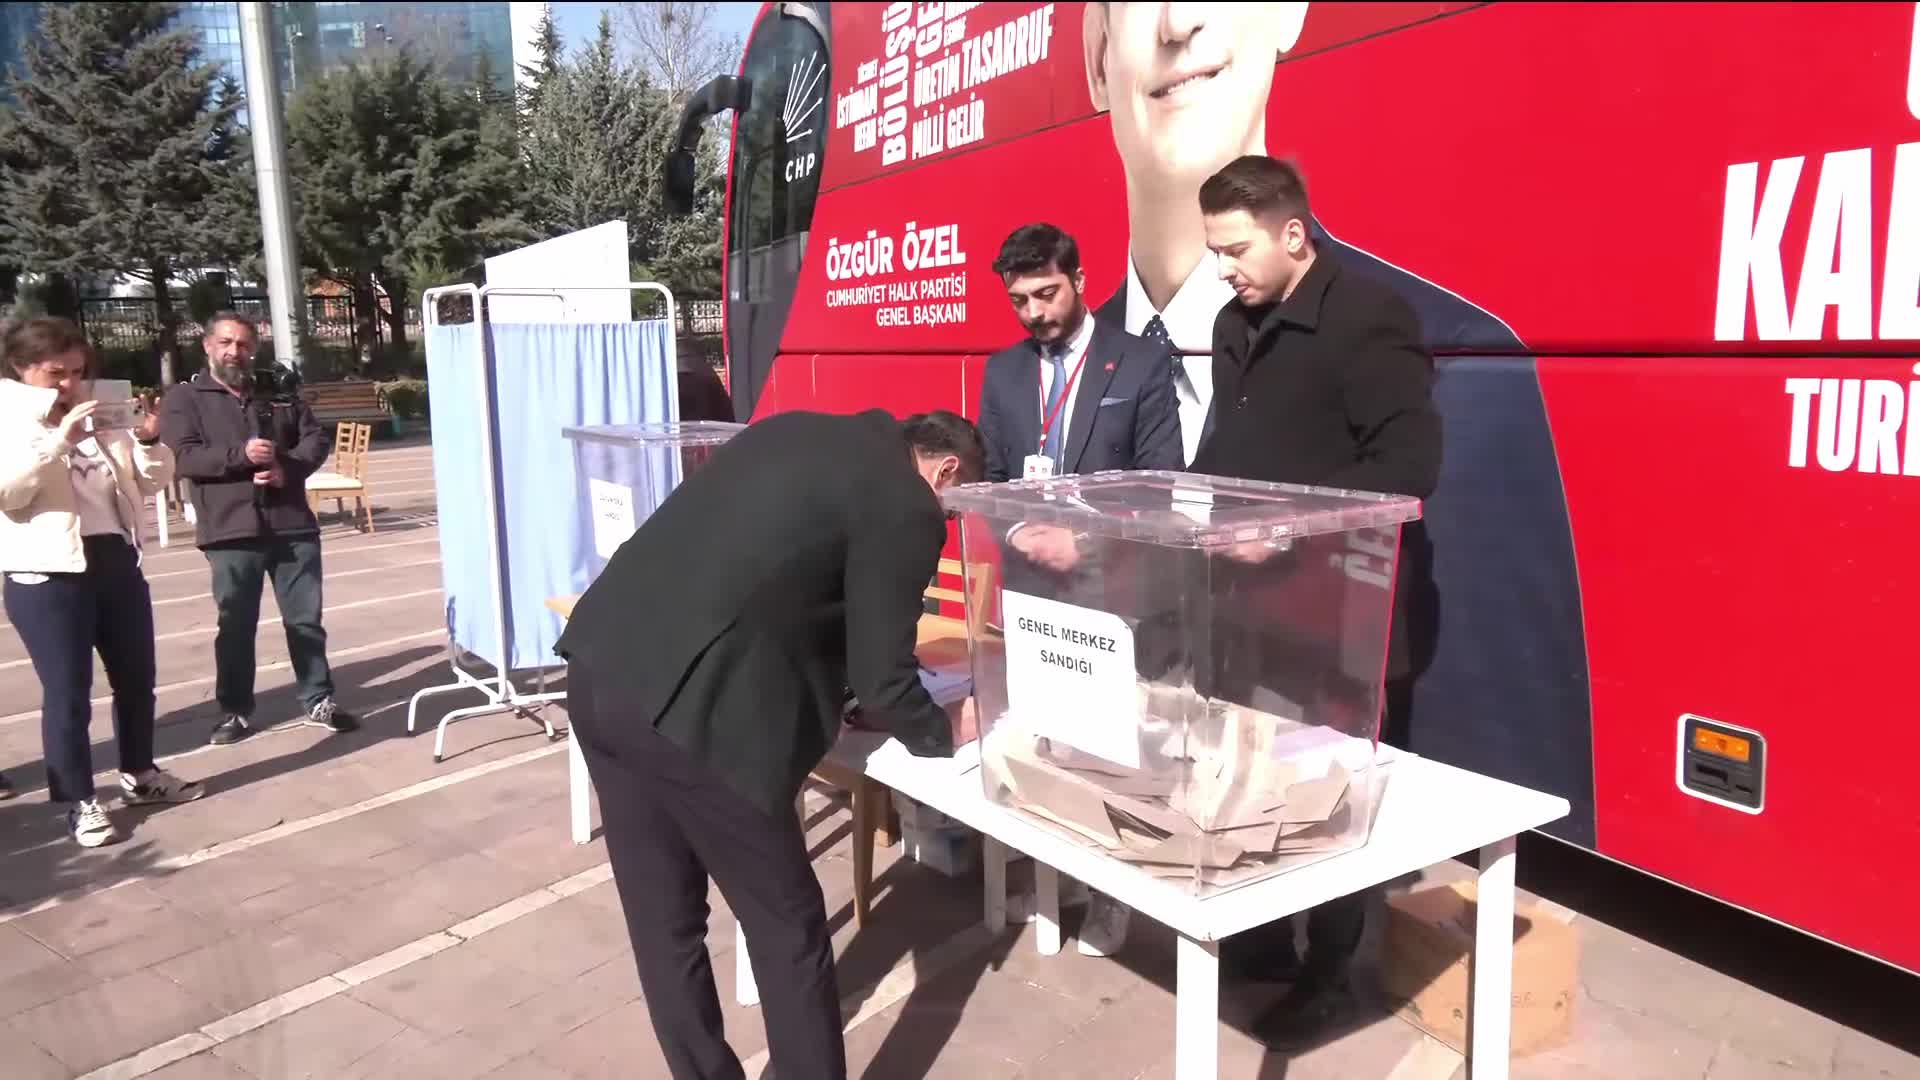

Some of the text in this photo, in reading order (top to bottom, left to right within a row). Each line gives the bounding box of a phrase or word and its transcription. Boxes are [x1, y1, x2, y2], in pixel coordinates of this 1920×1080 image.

[915, 2, 944, 58] GE
[914, 4, 1054, 107] ÜRETİM TASARRUF
[912, 92, 985, 160] MİLLİ GELİR
[785, 152, 815, 182] CHP
[826, 221, 967, 281] ÖZGÜR ÖZEL
[826, 271, 967, 307] CUMHURİYET HALK PARTİSİ
[876, 302, 966, 328] GENEL BAŞKANI
[1018, 617, 1116, 653] GENEL MERKEZ
[1040, 649, 1092, 675] SANDIĞI
